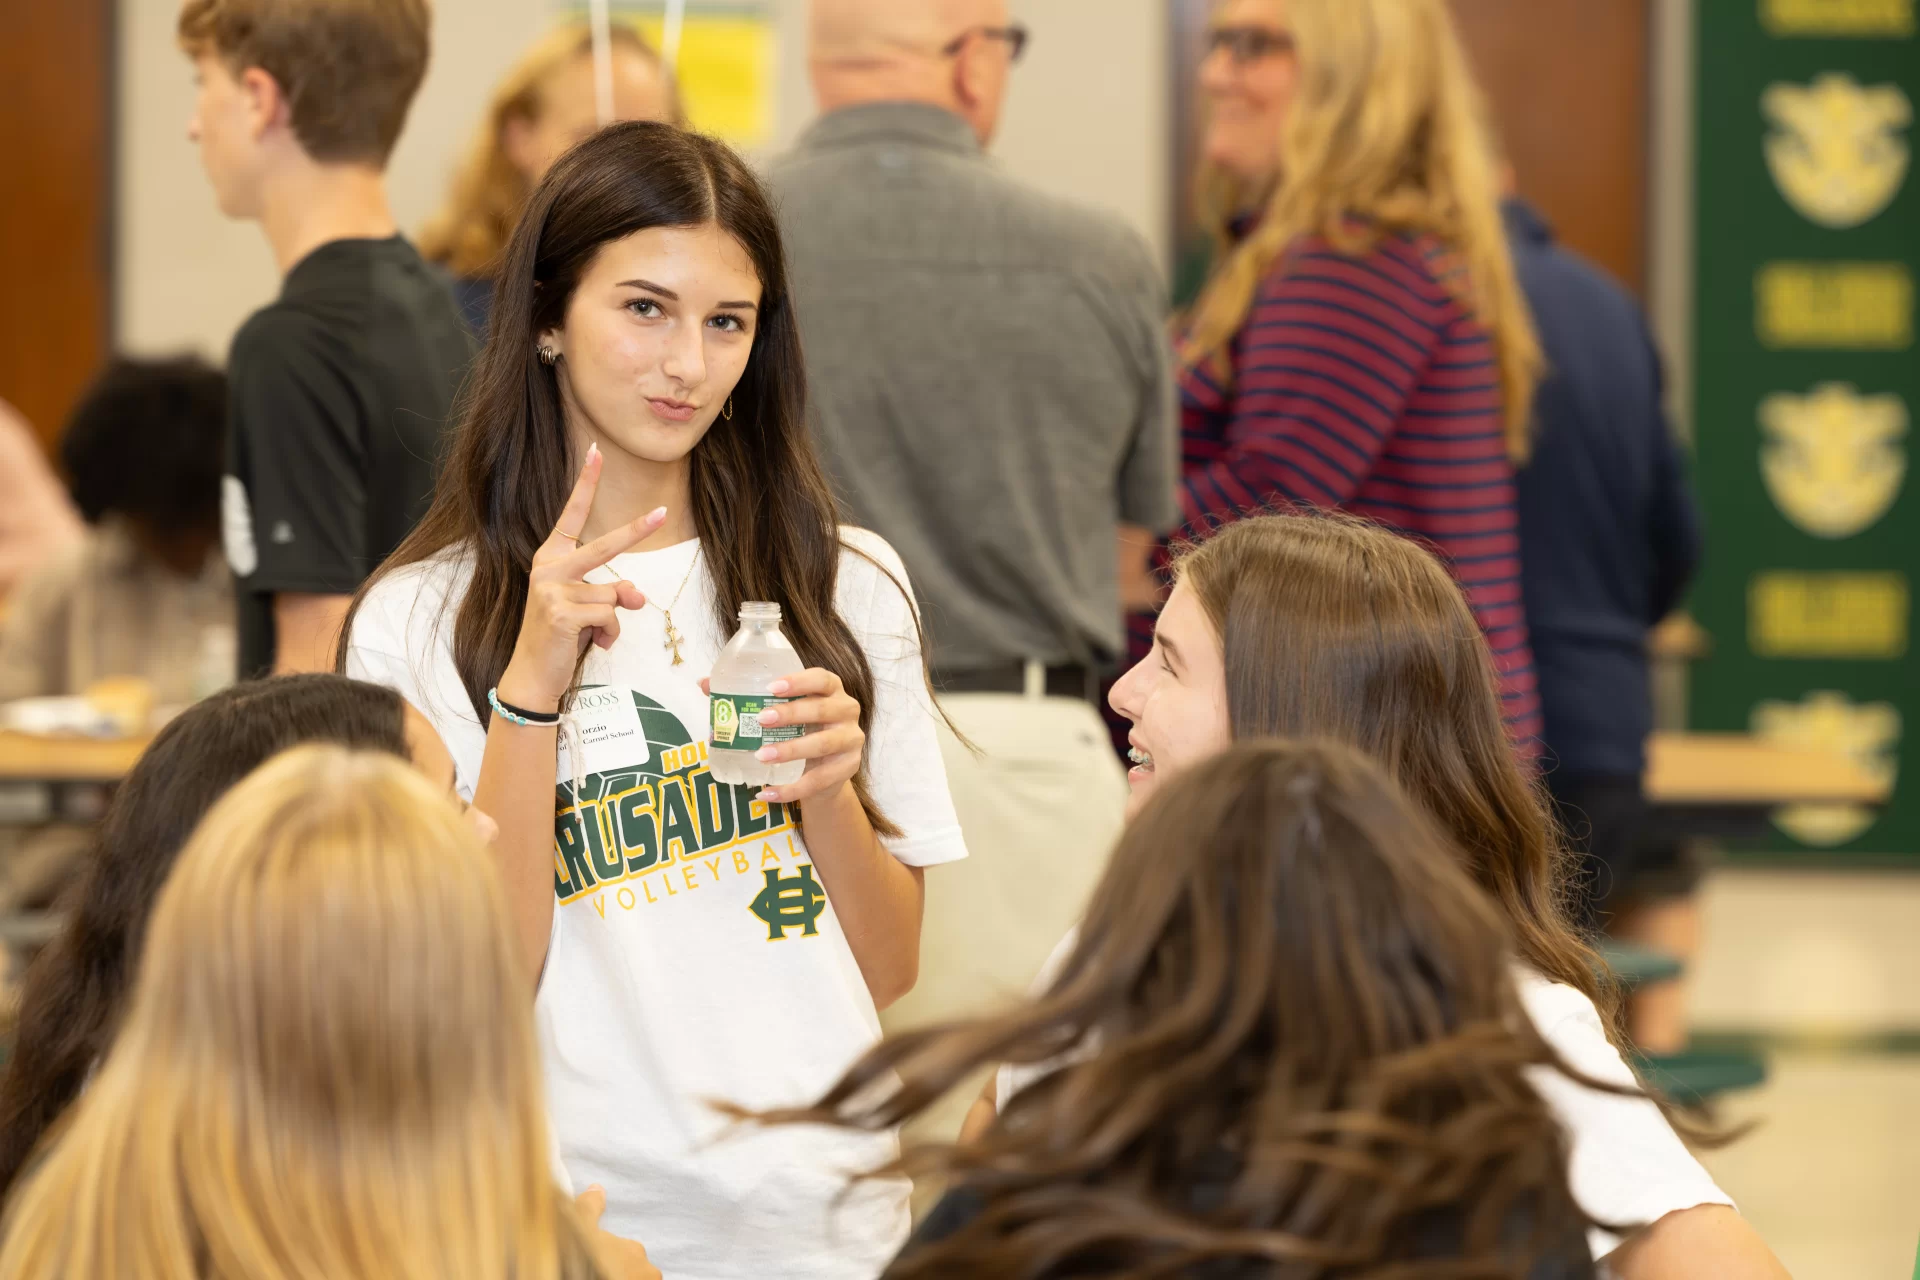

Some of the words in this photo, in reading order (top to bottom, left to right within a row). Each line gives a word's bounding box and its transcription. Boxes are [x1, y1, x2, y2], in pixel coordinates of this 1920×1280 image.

[582, 724, 607, 735] orzio
[582, 734, 609, 745] Carmel
[610, 729, 635, 740] School
[661, 741, 709, 773] HOL
[555, 766, 801, 905] RUSADE
[593, 835, 801, 919] VOLLEYBAL
